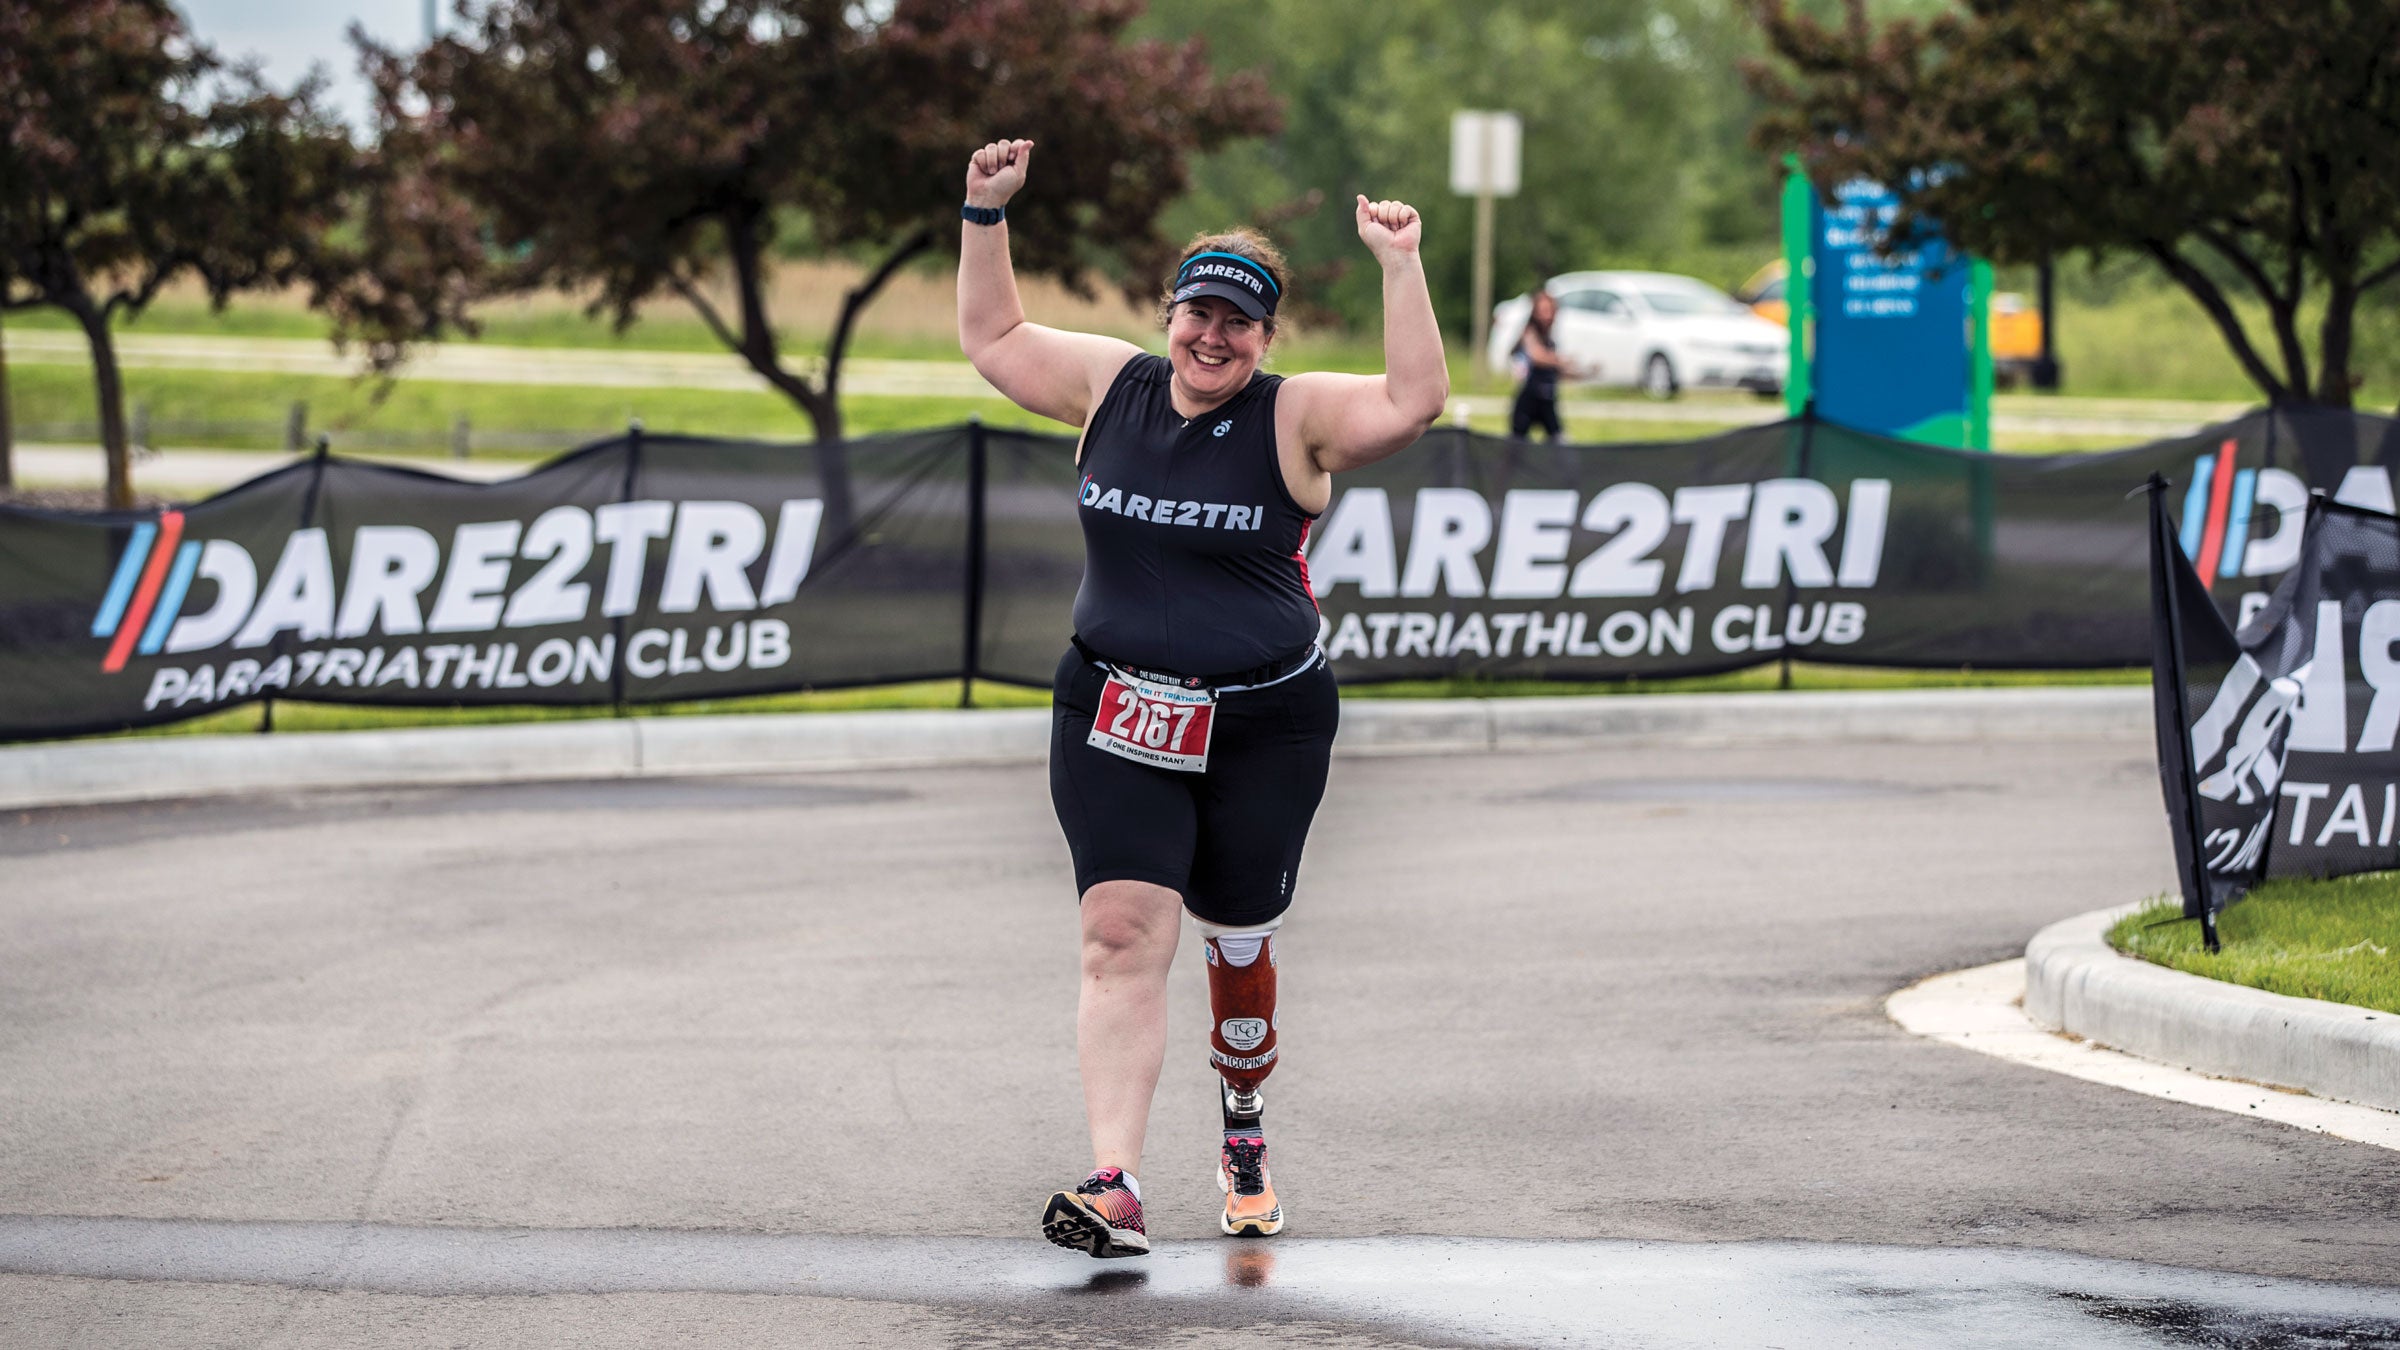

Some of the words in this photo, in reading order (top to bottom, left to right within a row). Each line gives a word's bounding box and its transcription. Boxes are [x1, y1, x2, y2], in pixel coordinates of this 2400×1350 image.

[1193, 264, 1264, 295] DARE2TRI
[1081, 481, 1264, 531] DARE2TRI
[1300, 477, 1892, 599] ARE2TRI
[138, 498, 824, 656] DARE2TRI
[1711, 601, 1868, 654] CLUB
[144, 634, 615, 712] PARATRIATHLON
[625, 618, 791, 680] CLUB
[1139, 670, 1149, 680] ONE
[1149, 672, 1168, 684] INSPIRES
[1168, 676, 1182, 686] MANY
[1139, 687, 1152, 696] TRI
[1154, 690, 1162, 698] IT
[1164, 692, 1208, 703] TRIATHLON
[1110, 690, 1196, 752] 2167
[1112, 741, 1126, 752] ONE
[1127, 746, 1160, 762] INSPIRES
[1161, 755, 1186, 766] MANY
